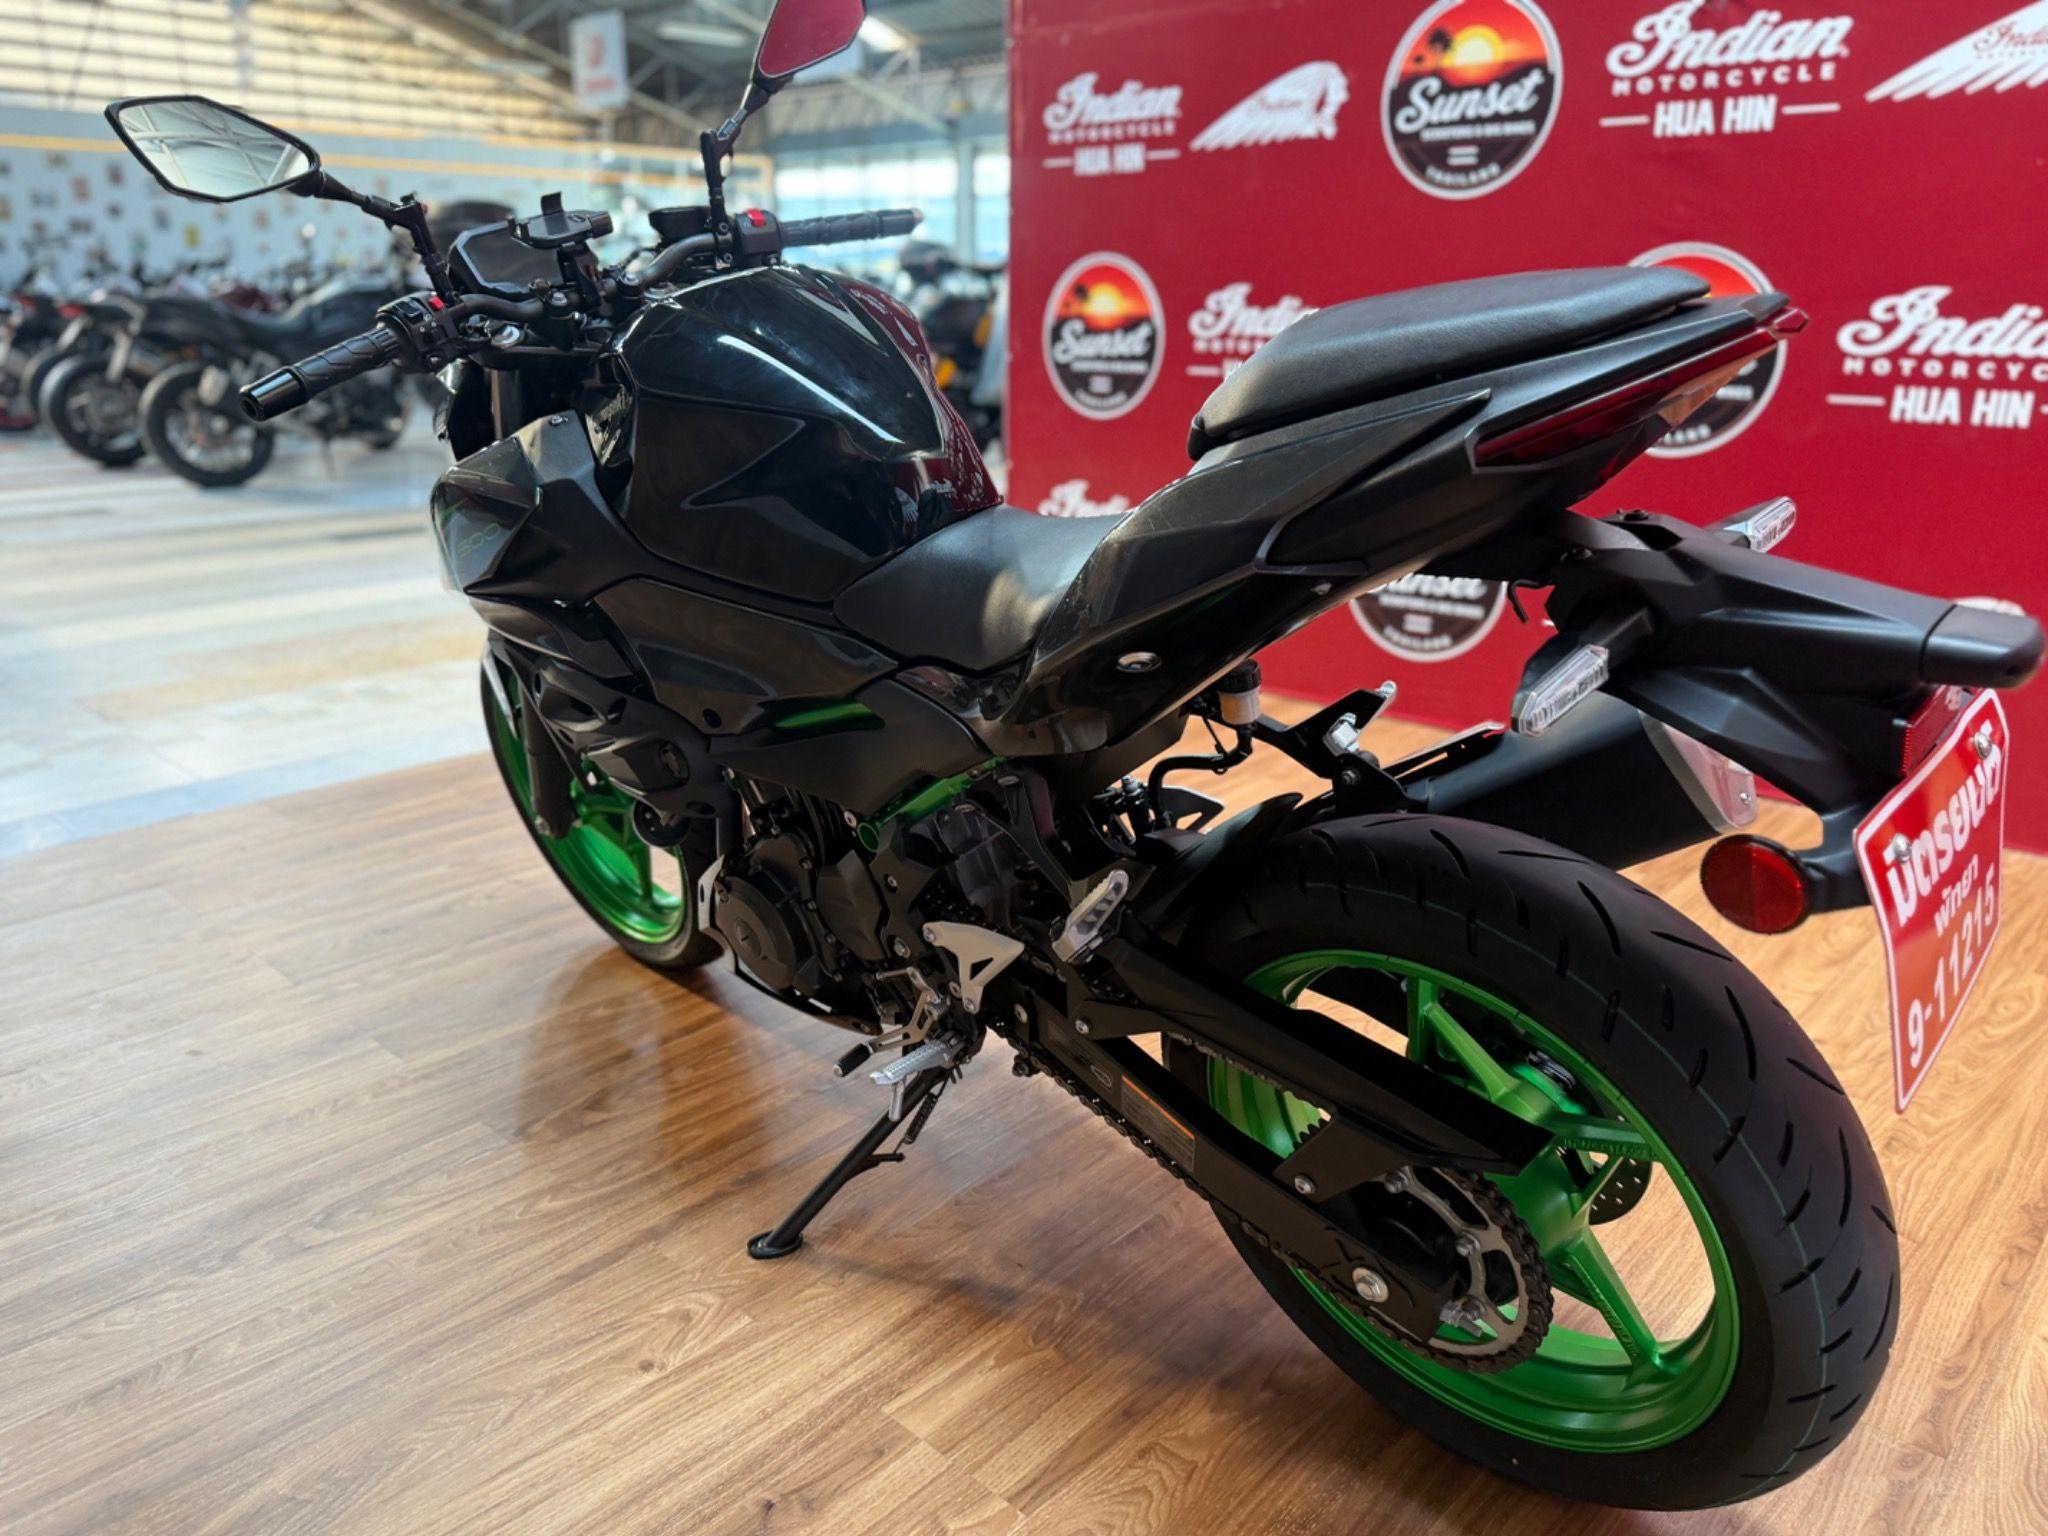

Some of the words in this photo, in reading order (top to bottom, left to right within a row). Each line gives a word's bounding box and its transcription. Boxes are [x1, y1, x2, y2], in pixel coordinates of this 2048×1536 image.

[1605, 0, 1854, 78] Indian
[1042, 72, 1183, 130] Indian
[1394, 68, 1546, 134] Sunset
[1611, 61, 1836, 96] MOTORCYCLE
[1653, 98, 1715, 138] HUA
[1722, 94, 1777, 134] HIN
[1053, 318, 1153, 365] Sunset
[1889, 385, 1961, 425] HUA
[1970, 387, 2035, 429] HIN
[1907, 862, 1995, 1069] 9-11215
